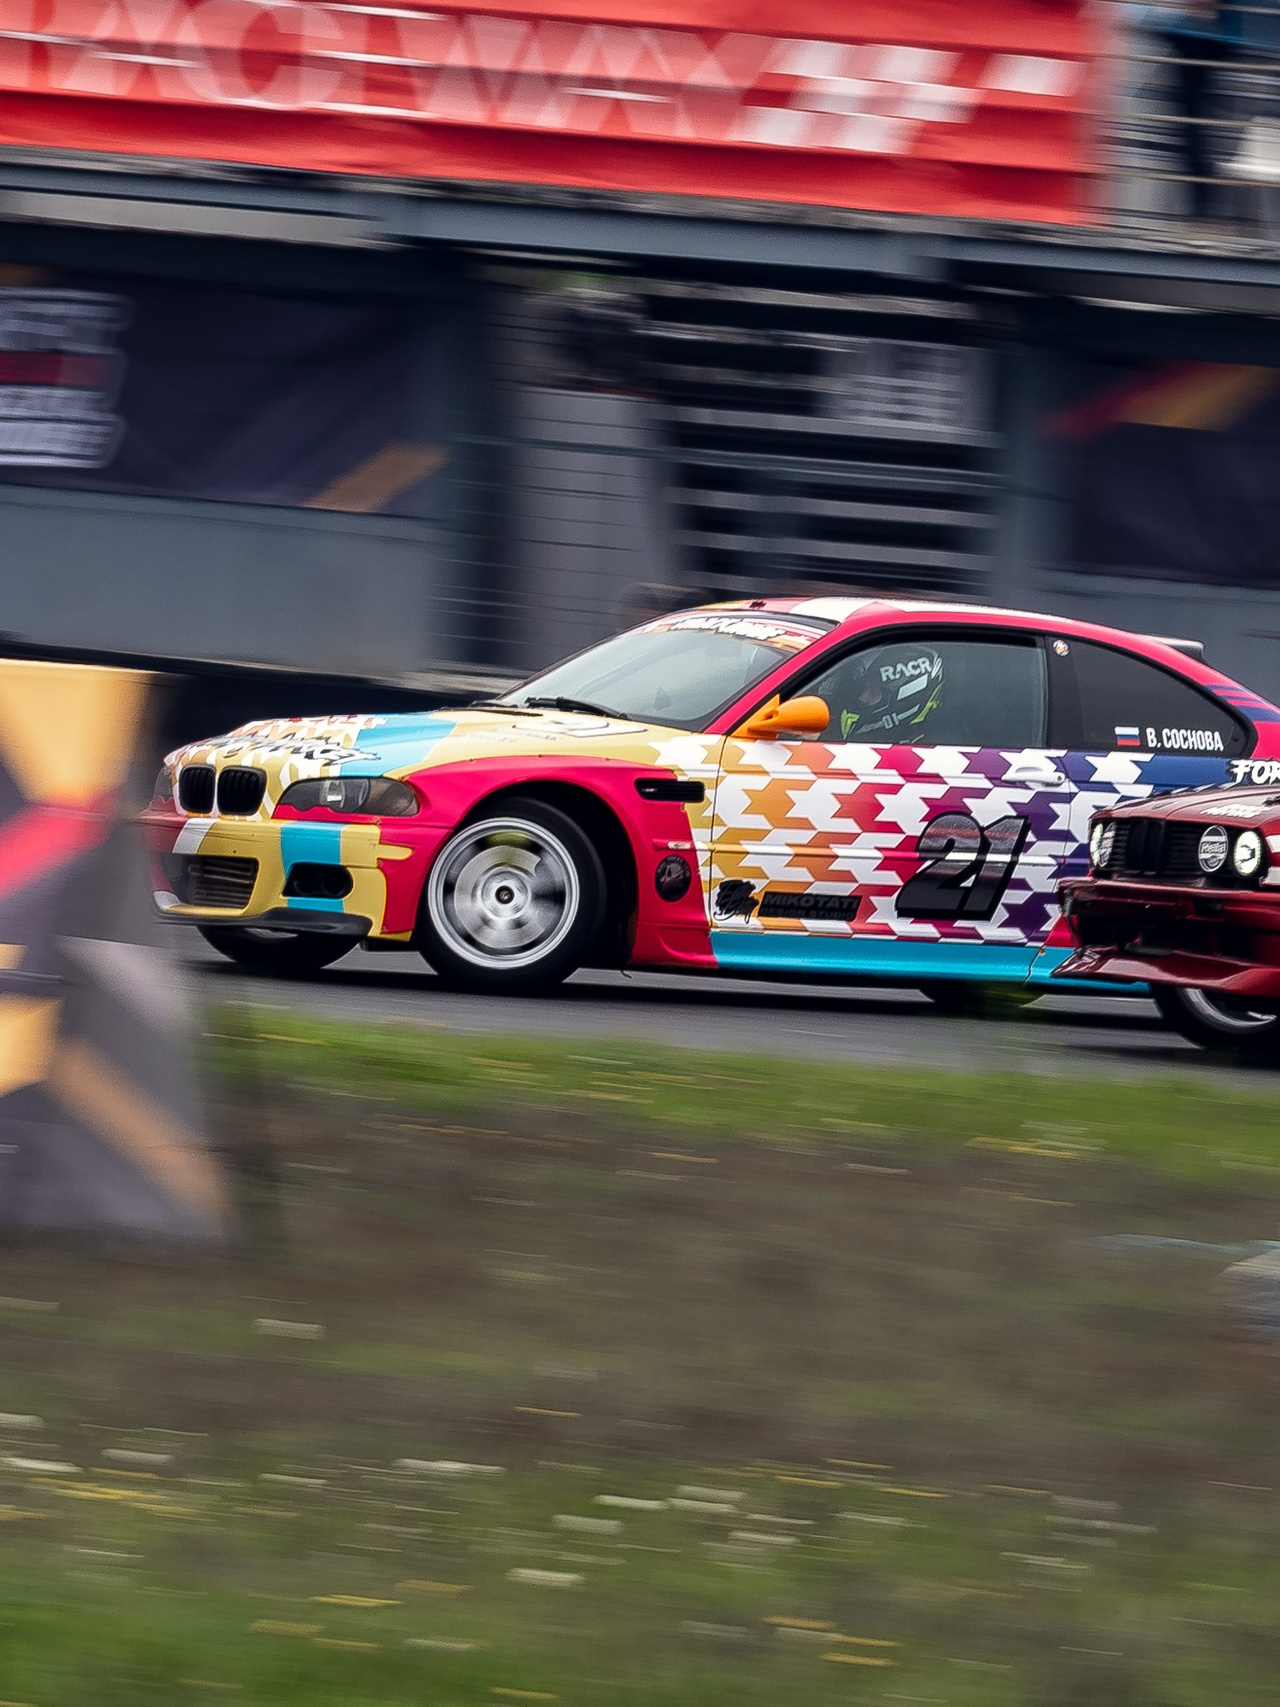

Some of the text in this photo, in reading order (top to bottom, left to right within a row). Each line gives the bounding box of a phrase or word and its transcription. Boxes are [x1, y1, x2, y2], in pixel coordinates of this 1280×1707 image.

[1162, 728, 1224, 751] СОСНОВА
[896, 812, 1031, 921] 21
[764, 893, 858, 909] MIKOTATI
